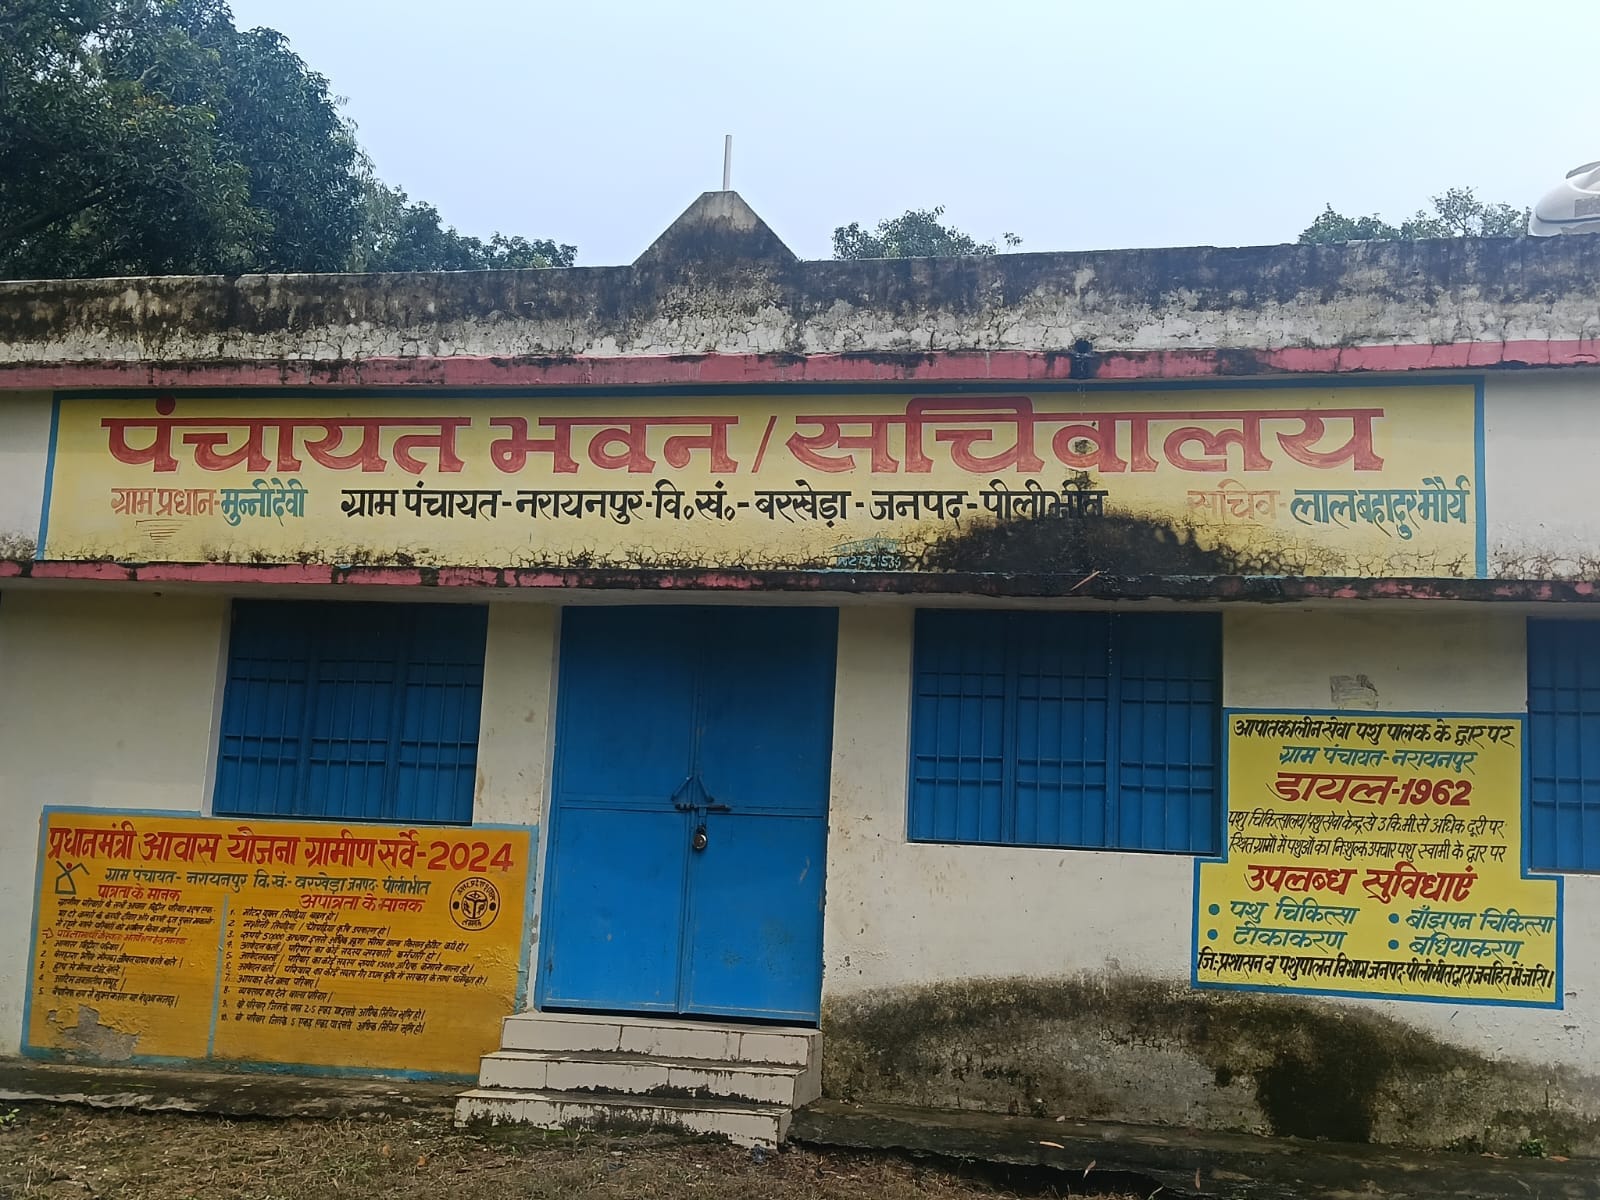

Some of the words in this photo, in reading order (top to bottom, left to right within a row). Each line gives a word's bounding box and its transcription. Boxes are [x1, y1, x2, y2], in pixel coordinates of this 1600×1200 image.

[101, 395, 471, 474] पंचायत
[490, 416, 738, 474] भवन
[785, 396, 1384, 474] सचिवालय
[111, 488, 156, 516] ग्राम
[341, 489, 399, 518] ग्राम
[1356, 722, 1387, 745] पशु
[1387, 723, 1432, 744] पालक
[1434, 719, 1452, 742] के
[1455, 725, 1487, 749] द्वार
[1488, 725, 1515, 748] पर
[1280, 746, 1320, 764] ग्राम
[1392, 749, 1478, 775] नरायनपुर
[1229, 810, 1249, 831] पशु
[1430, 814, 1469, 834] अधिक
[1467, 815, 1488, 837] दूरी
[1489, 820, 1505, 838] पर
[48, 820, 137, 860] प्रधानमंत्री
[139, 831, 222, 865] आवास
[304, 828, 378, 868] ग्रामीण
[1314, 840, 1331, 855] का
[1397, 843, 1418, 863] पशु
[1418, 839, 1451, 860] स्वामी
[1452, 840, 1464, 860] के
[1467, 845, 1488, 863] द्वार
[1490, 845, 1507, 862] पर
[105, 868, 131, 881] ग्राम
[1244, 865, 1358, 895] उपलब्ध
[1362, 861, 1478, 904] सुविधाएं
[148, 888, 182, 901] मानक
[361, 893, 377, 911] के
[379, 897, 425, 913] मानक
[1230, 901, 1269, 924] पशु
[1274, 896, 1360, 926] चिकित्सा
[1480, 907, 1556, 936] चिकित्सा
[1233, 921, 1348, 953] टीकाकरण
[1409, 932, 1524, 963] बधियाकरण
